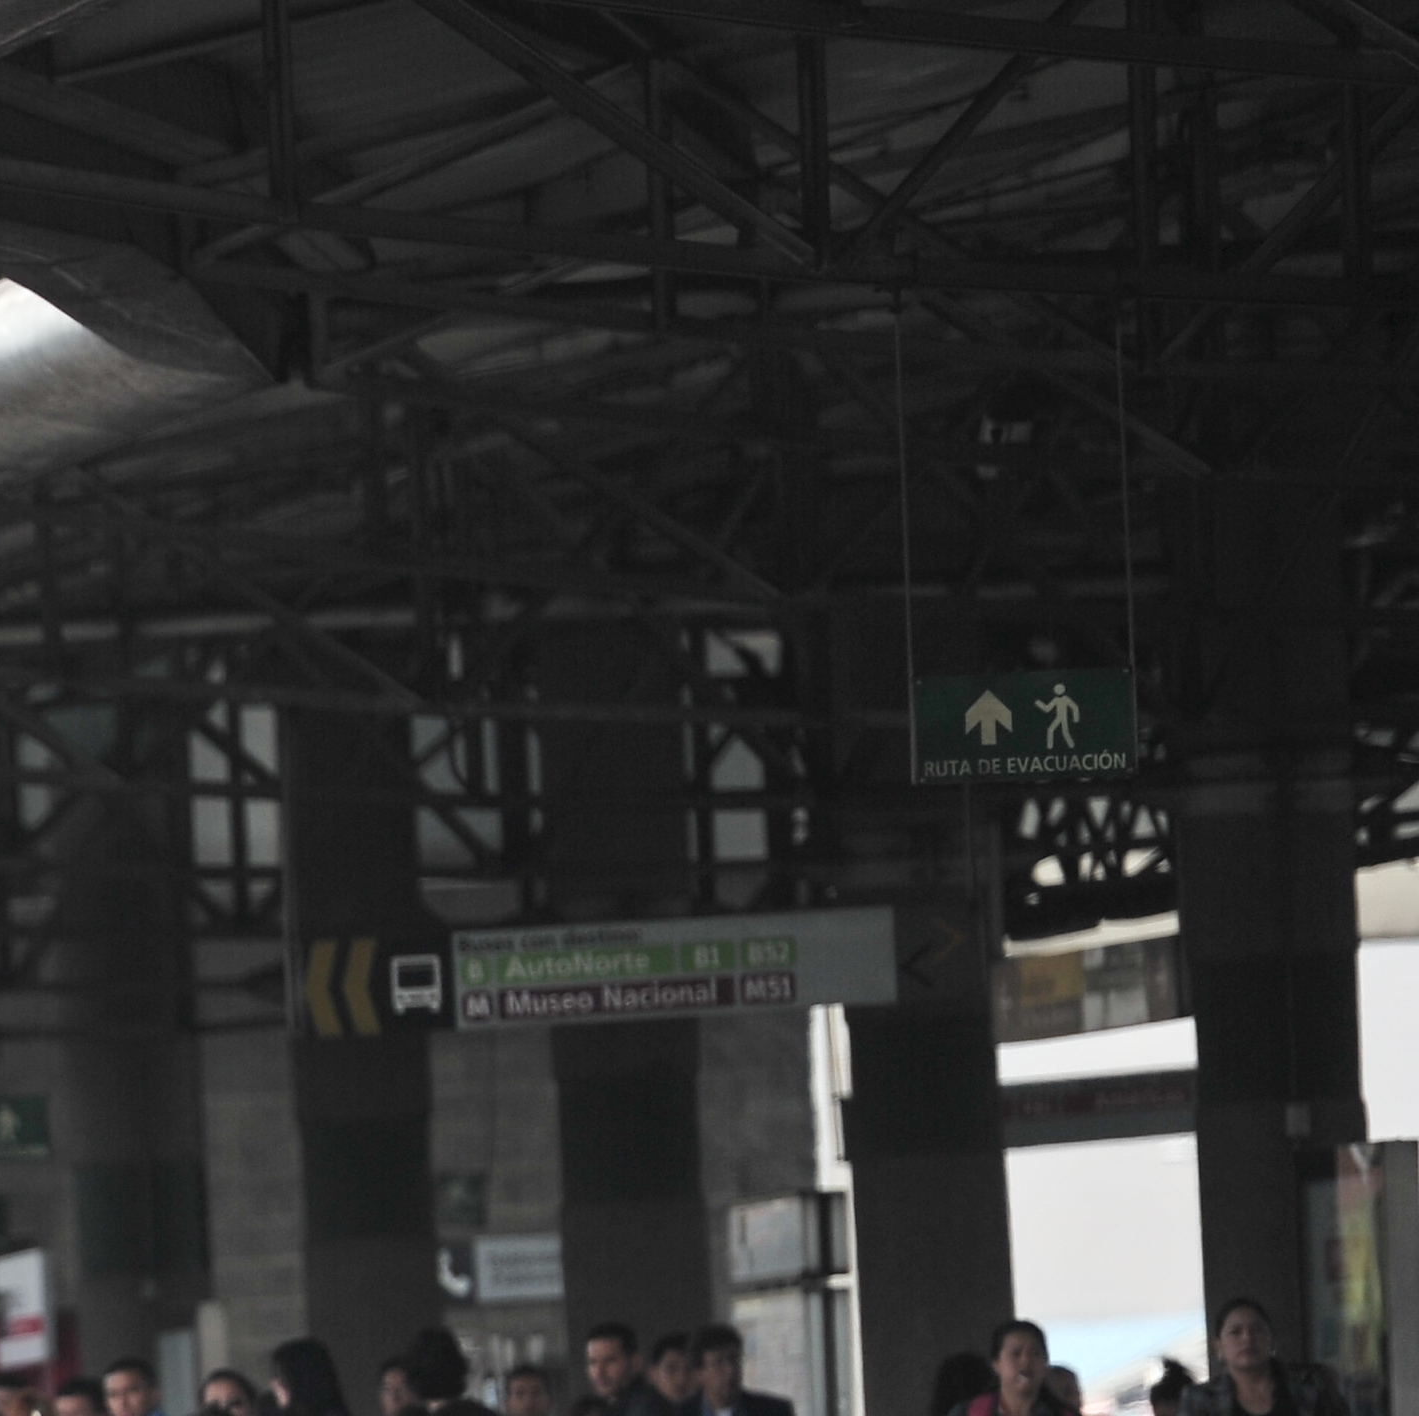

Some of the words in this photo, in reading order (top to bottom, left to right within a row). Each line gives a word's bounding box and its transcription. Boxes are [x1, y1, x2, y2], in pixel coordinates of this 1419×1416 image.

[923, 758, 972, 777] RUTA
[977, 757, 1001, 775] DE
[1006, 750, 1127, 774] EVACUACIÓN
[504, 950, 650, 980] AutoNorte
[466, 992, 490, 1016] M
[505, 987, 594, 1015] Museo
[603, 977, 716, 1010] Nacional
